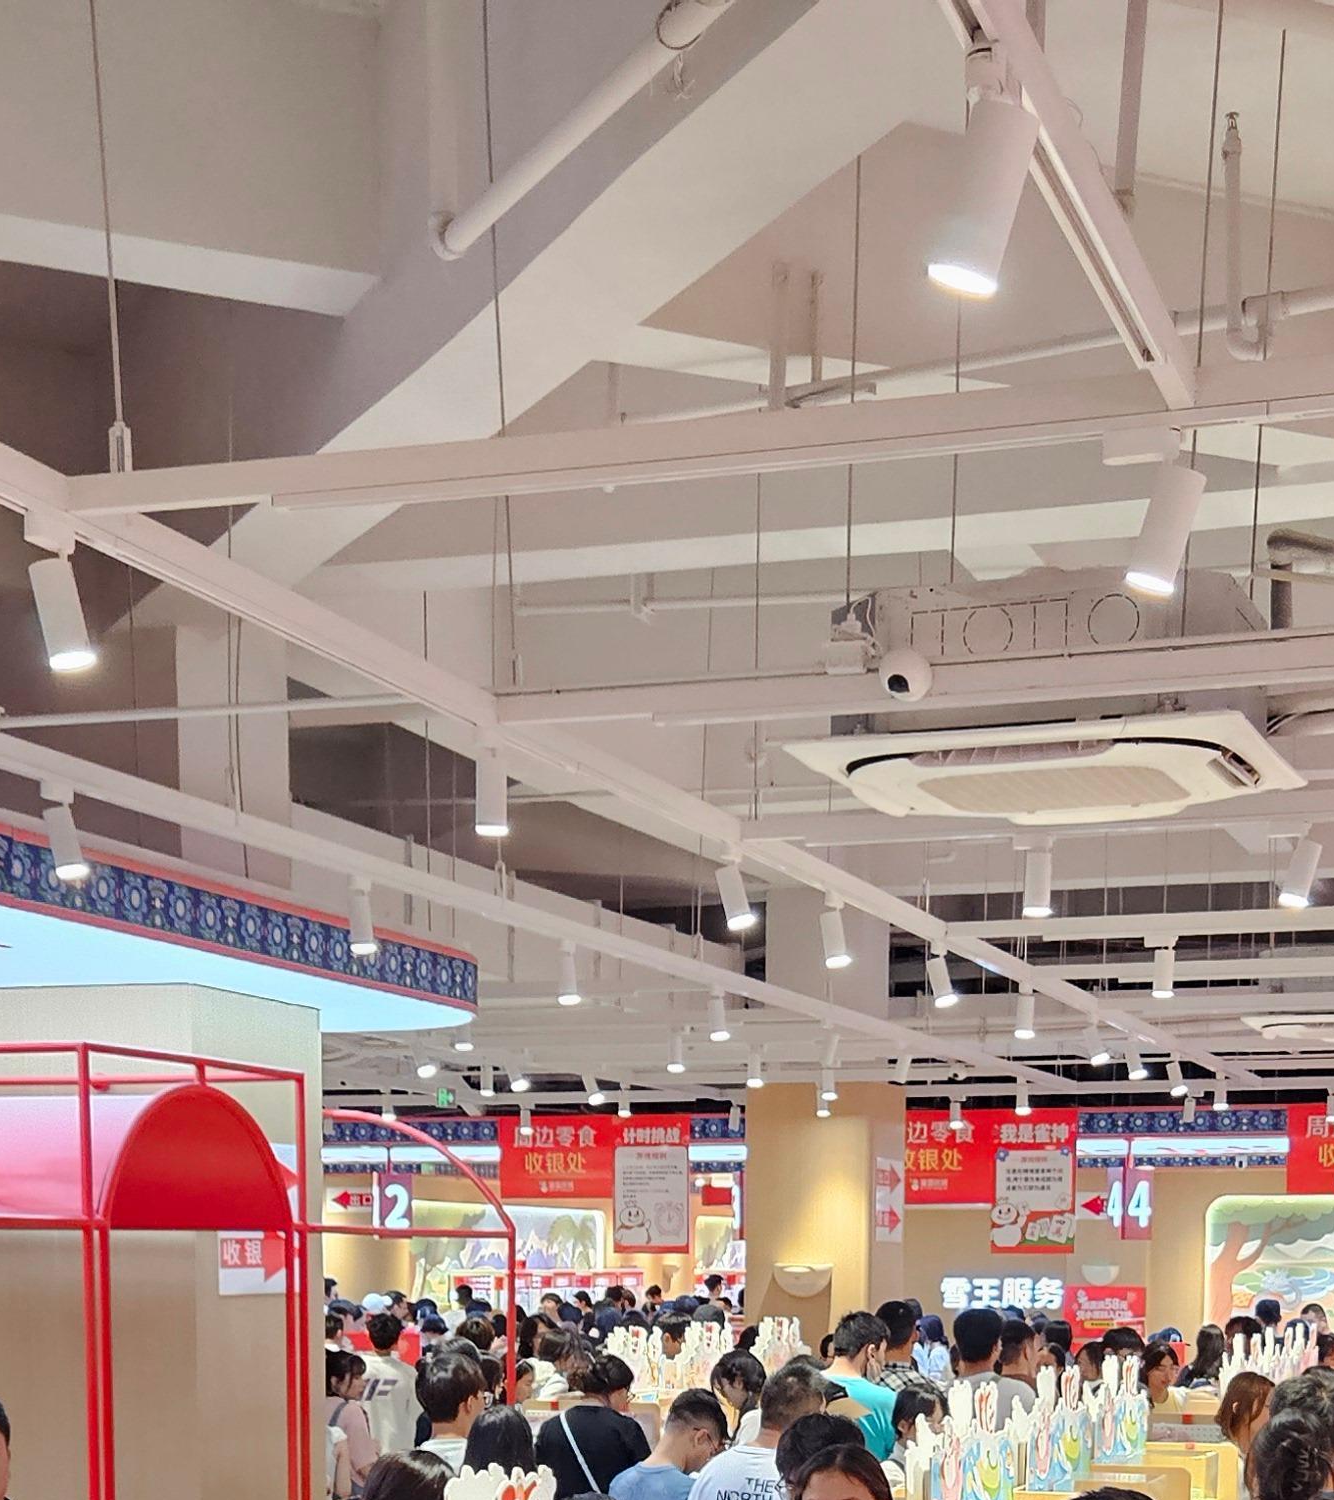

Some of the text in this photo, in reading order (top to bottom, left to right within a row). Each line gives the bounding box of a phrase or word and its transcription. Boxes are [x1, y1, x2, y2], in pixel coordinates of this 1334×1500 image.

[525, 1152, 587, 1175] 收银处
[1107, 1180, 1123, 1228] 4
[1128, 1180, 1152, 1228] 4
[222, 1240, 263, 1265] 收银
[940, 1276, 1064, 1310] 雪王服务
[745, 1477, 775, 1493] THE
